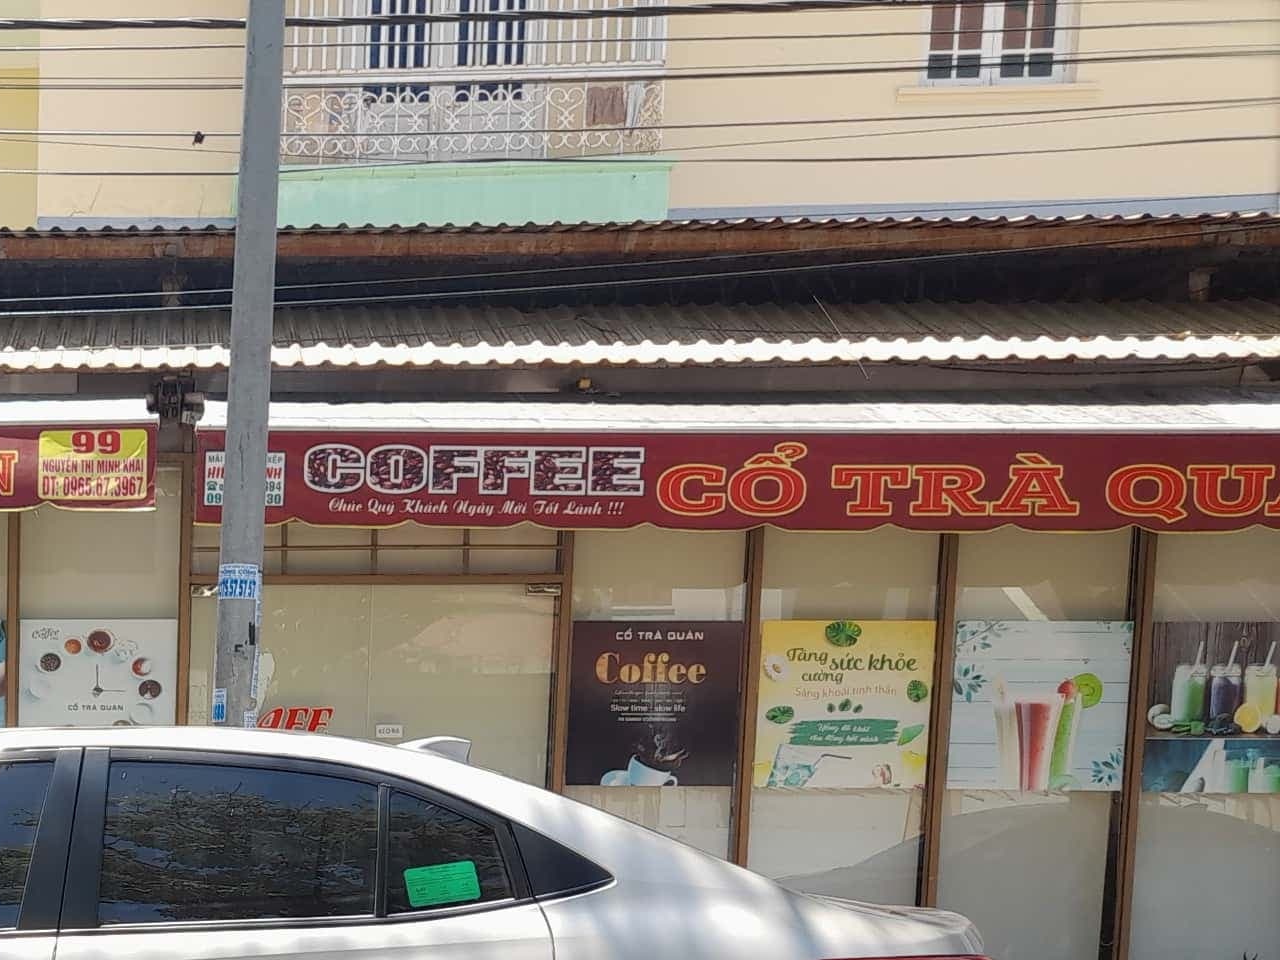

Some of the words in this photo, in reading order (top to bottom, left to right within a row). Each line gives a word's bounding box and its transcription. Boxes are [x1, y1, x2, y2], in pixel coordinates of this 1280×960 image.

[72, 431, 120, 454] 99
[97, 458, 119, 473] MINH
[123, 458, 144, 473] KHAI
[304, 444, 645, 496] COFFEE
[63, 476, 144, 497] 0965.67.3967
[657, 441, 807, 518] CỔ
[832, 452, 1080, 518] TRÀ
[1106, 464, 1280, 524] QU
[328, 497, 362, 512] Chúc
[400, 498, 448, 514] Khách
[452, 499, 494, 516] Ngày
[786, 648, 829, 665] Tăng
[829, 653, 864, 671] sức
[868, 652, 918, 671] khỏe
[595, 651, 706, 684] Coffee
[801, 670, 844, 684] cường
